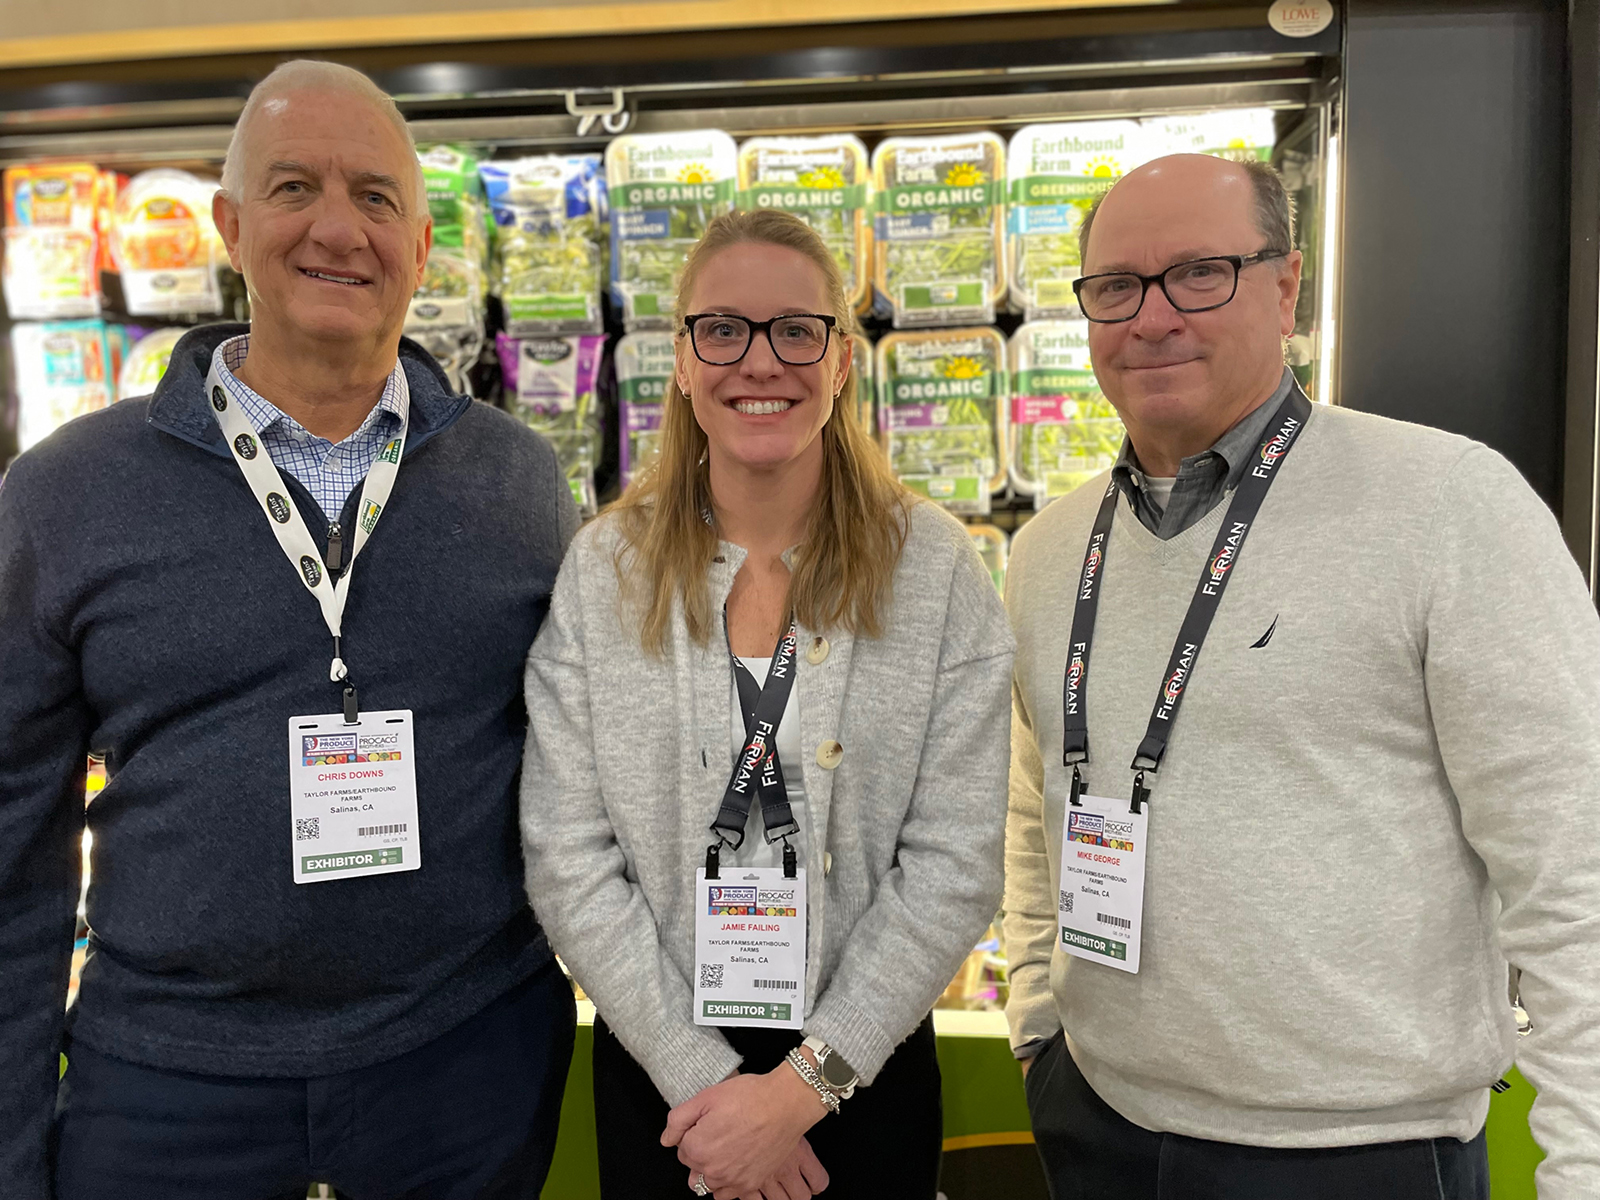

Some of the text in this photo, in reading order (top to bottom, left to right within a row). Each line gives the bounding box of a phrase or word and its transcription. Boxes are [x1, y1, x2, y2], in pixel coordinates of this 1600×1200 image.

[1282, 8, 1320, 21] LOWE
[1031, 134, 1124, 155] Earthbound
[627, 145, 714, 163] Earthbound
[1031, 155, 1071, 173] Farm
[628, 166, 667, 179] Farm
[629, 185, 716, 205] ORGANIC
[757, 190, 844, 208] ORGANIC
[896, 187, 985, 208] ORGANIC
[1033, 351, 1072, 366] Farm
[896, 379, 984, 400] ORGANIC
[1252, 416, 1299, 479] FIERMAN
[1082, 532, 1105, 600] FIERMAN
[1202, 521, 1246, 596] FIERMAN
[1067, 642, 1087, 715] FIERMAN
[1156, 642, 1196, 721] FIERMAN
[319, 740, 354, 748] PRODUCE
[734, 720, 774, 794] FIERMAN
[317, 770, 384, 782] CHRIS DOWNS
[304, 785, 397, 799] TAYLOR FARMS/EARTHBOUND
[330, 805, 361, 814] Salinas,
[1079, 820, 1102, 828] PRODUCE
[306, 854, 374, 870] EXHIBITOR
[1077, 851, 1121, 867] MIKE GEORGE
[1067, 865, 1083, 874] TAYLOR
[1089, 877, 1104, 886] FARMS
[1081, 885, 1110, 898] Salinas, CA
[721, 923, 780, 932] JAMIE FAILING
[731, 939, 790, 948] FARMS/EARTHBOUND
[1064, 931, 1106, 952] EXHIBITOR
[730, 956, 769, 965] Salinas, CA
[707, 1004, 766, 1016] EXHIBITOR
